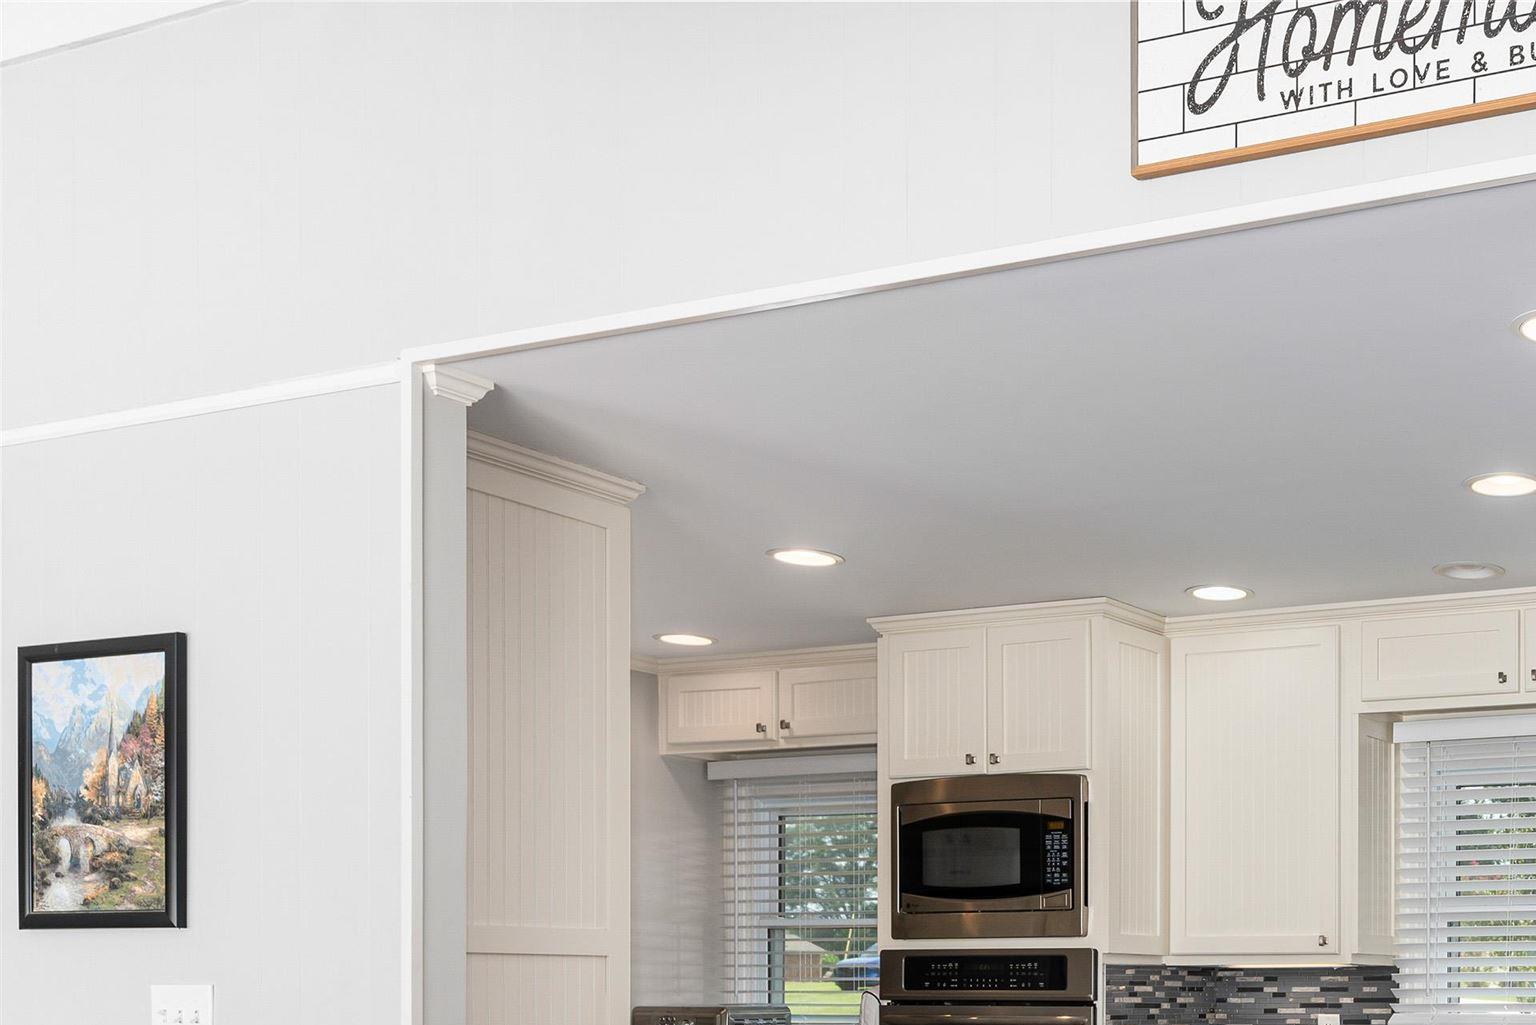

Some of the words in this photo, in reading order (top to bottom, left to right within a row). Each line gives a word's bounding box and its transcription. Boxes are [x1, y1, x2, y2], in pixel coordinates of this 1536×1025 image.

[1280, 77, 1352, 110] WITH
[1372, 61, 1450, 93] LOVE
[1471, 51, 1489, 73] &
